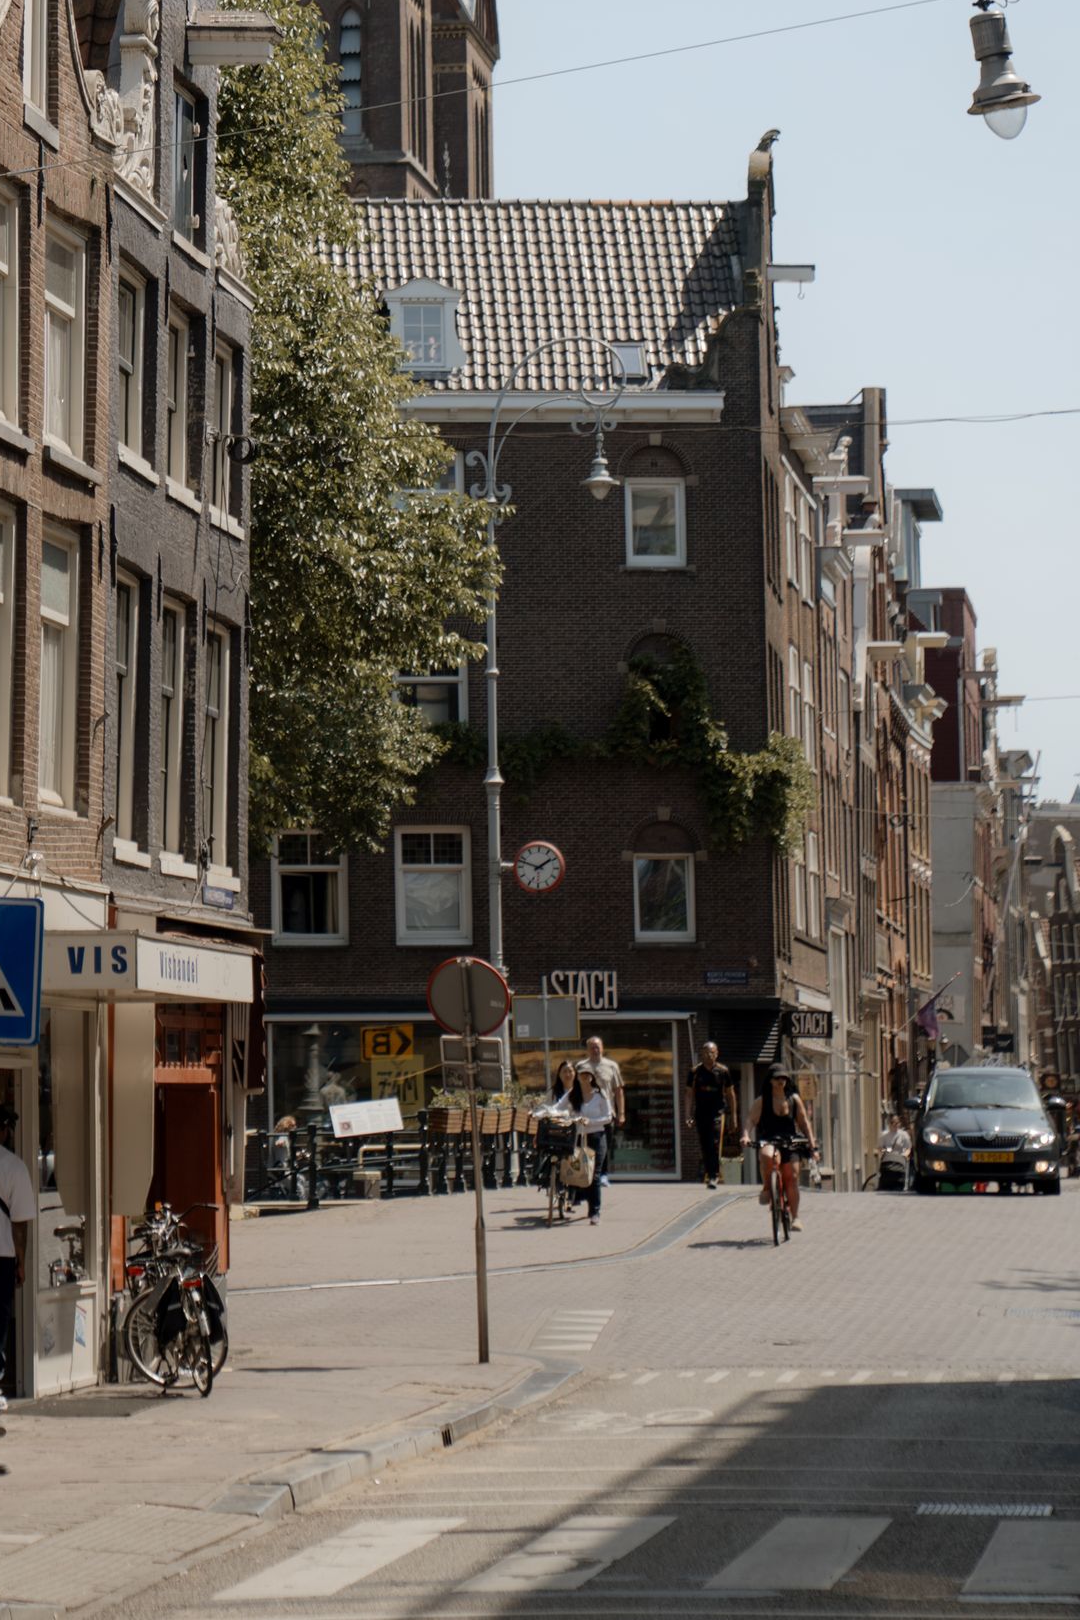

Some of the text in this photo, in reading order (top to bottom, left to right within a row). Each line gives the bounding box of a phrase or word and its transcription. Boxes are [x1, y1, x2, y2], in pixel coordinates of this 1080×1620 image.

[67, 945, 128, 975] VIS
[160, 951, 198, 984] Vishandel
[550, 970, 618, 1010] STACH
[791, 1012, 828, 1035] STACH
